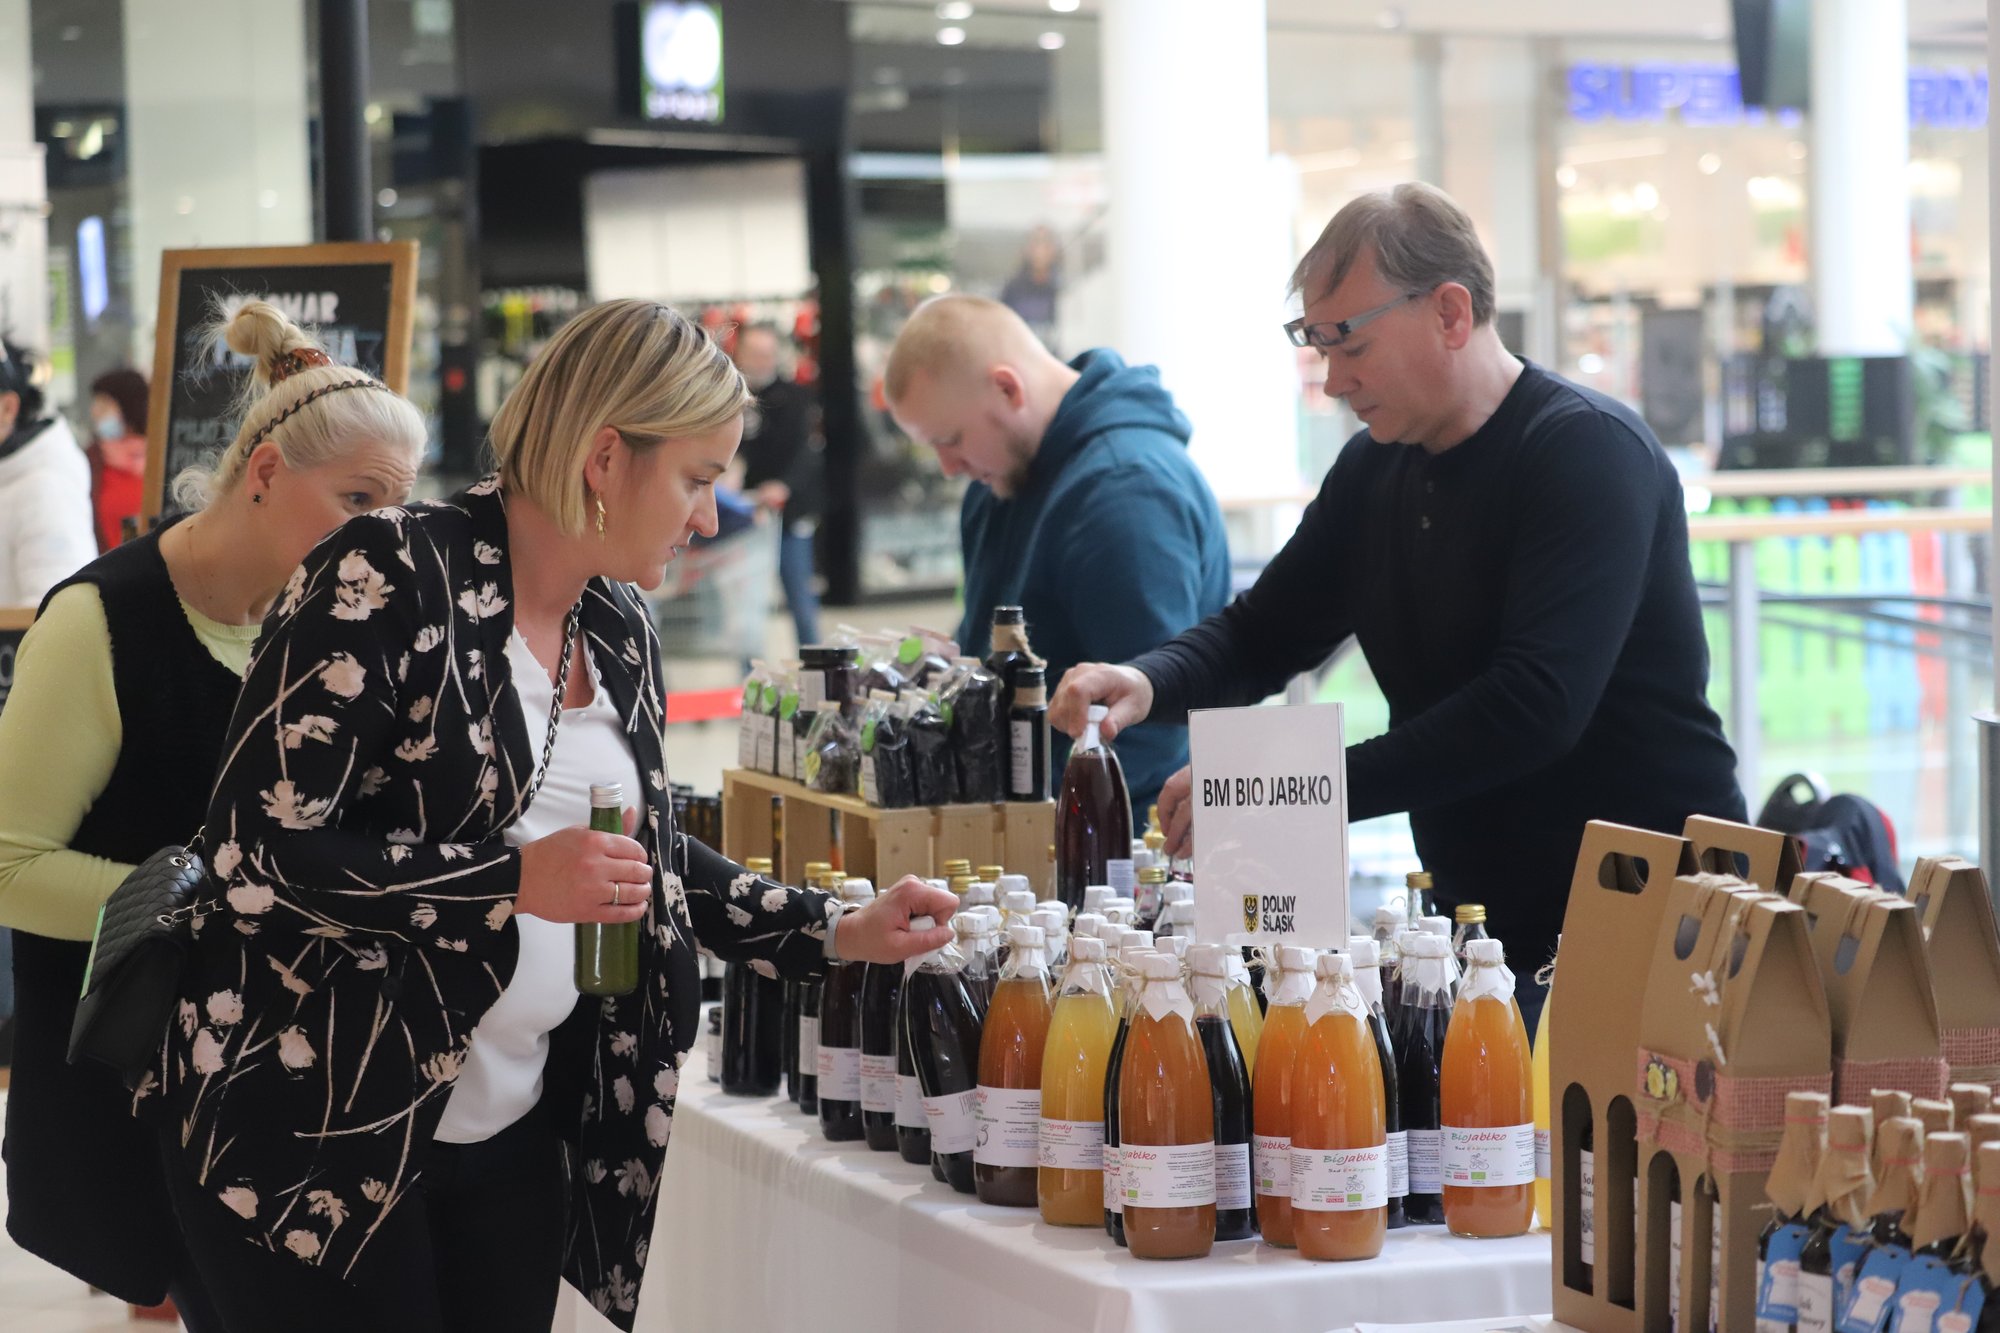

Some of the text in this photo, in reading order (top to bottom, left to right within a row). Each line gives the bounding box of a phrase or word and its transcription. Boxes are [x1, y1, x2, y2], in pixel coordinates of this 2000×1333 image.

[1570, 65, 1742, 127] SUPE
[1203, 775, 1332, 807] BM BIO JABŁKO
[1262, 895, 1297, 913] DOLNY
[1262, 911, 1296, 935] ŚLĄSK
